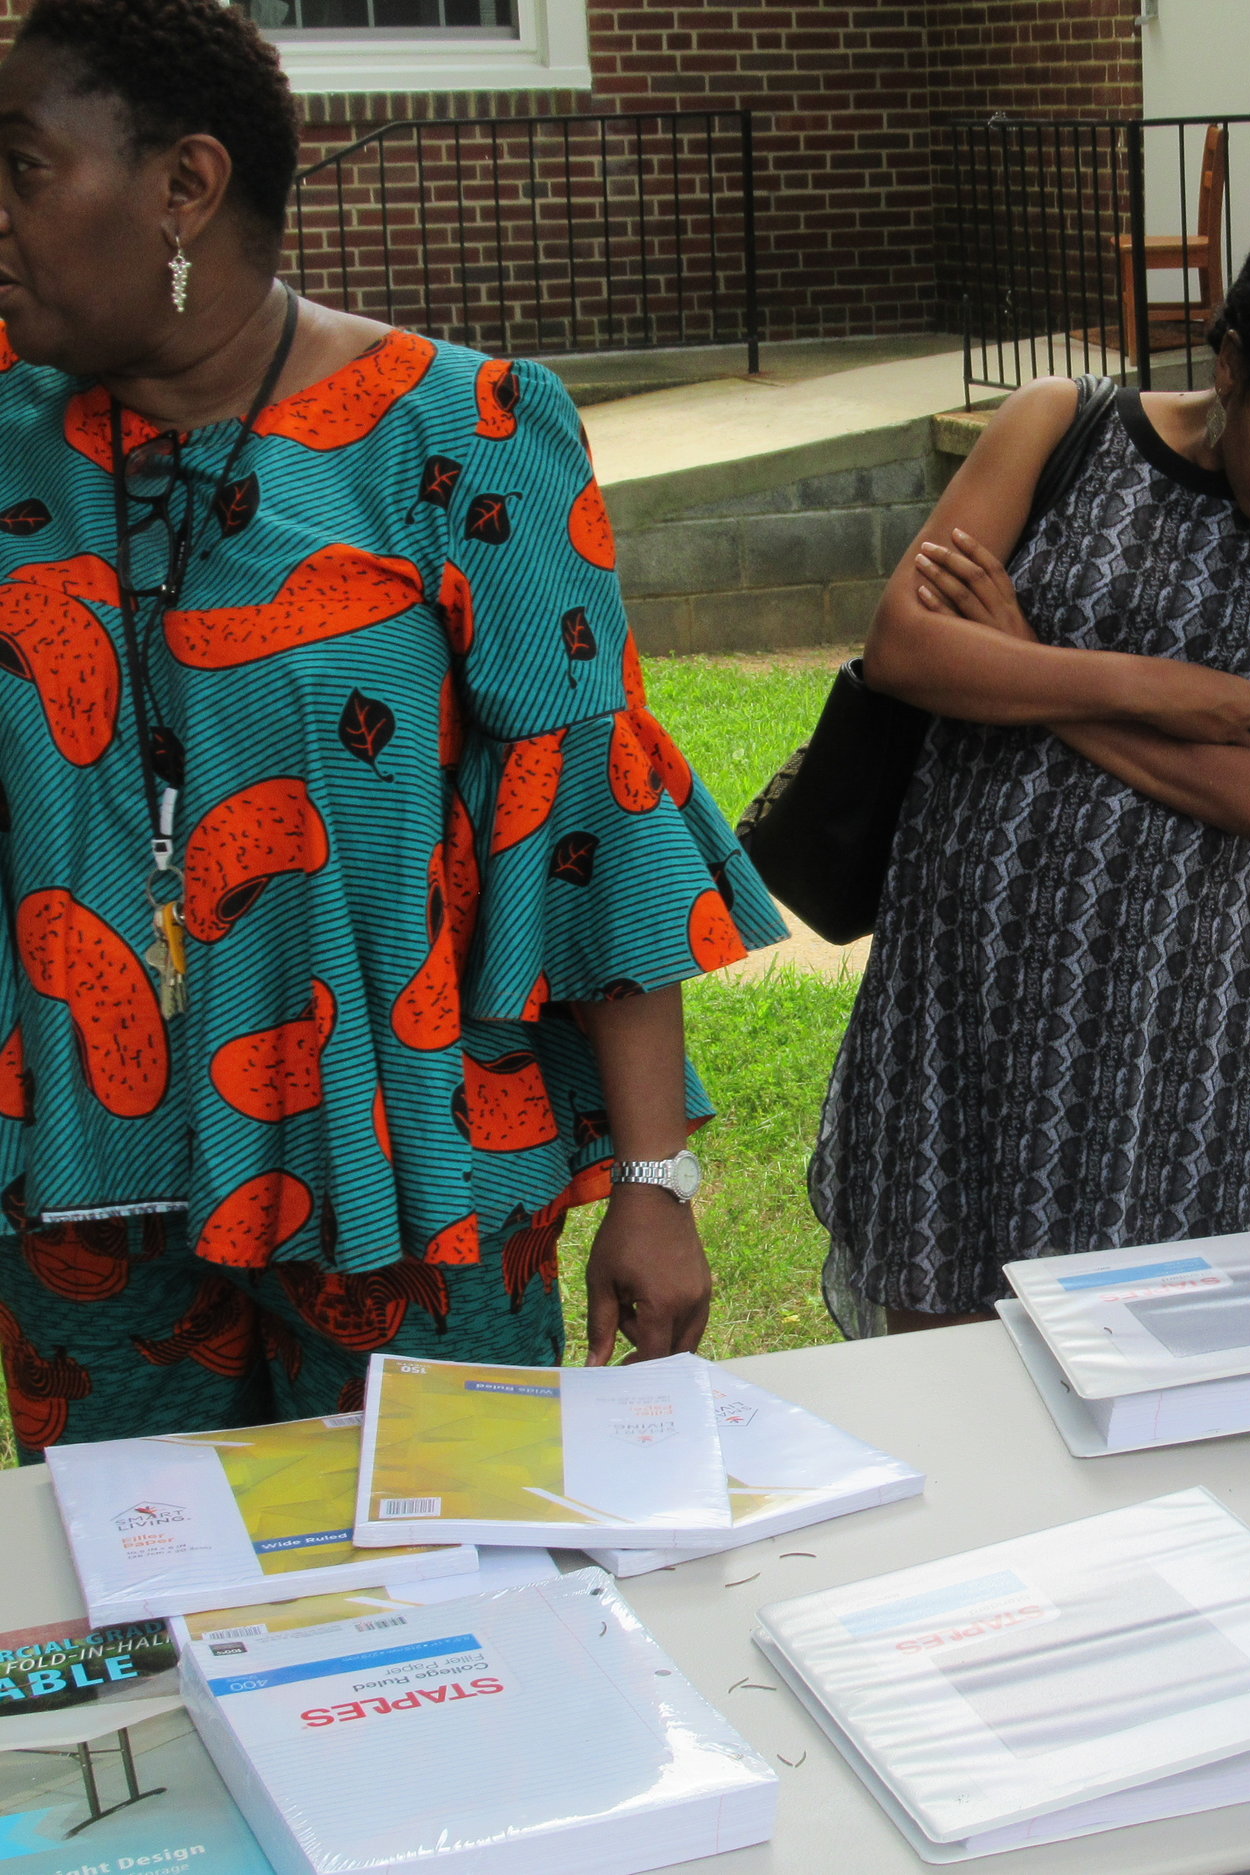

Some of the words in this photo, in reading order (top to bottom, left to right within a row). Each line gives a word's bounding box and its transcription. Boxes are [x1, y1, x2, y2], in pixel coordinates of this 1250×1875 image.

[115, 1509, 185, 1525] SMART
[122, 1533, 167, 1544] Filler
[123, 1537, 176, 1549] Paper
[261, 1540, 300, 1550] Wide
[305, 1532, 347, 1544] Ruled
[895, 1605, 1046, 1656] STAPLES
[385, 1659, 439, 1677] Paper
[440, 1653, 485, 1666] Filler
[410, 1662, 489, 1680] College
[230, 1679, 269, 1692] 400
[353, 1675, 410, 1693] Ruled
[300, 1677, 504, 1728] STAPLES
[117, 1845, 206, 1870] Design
